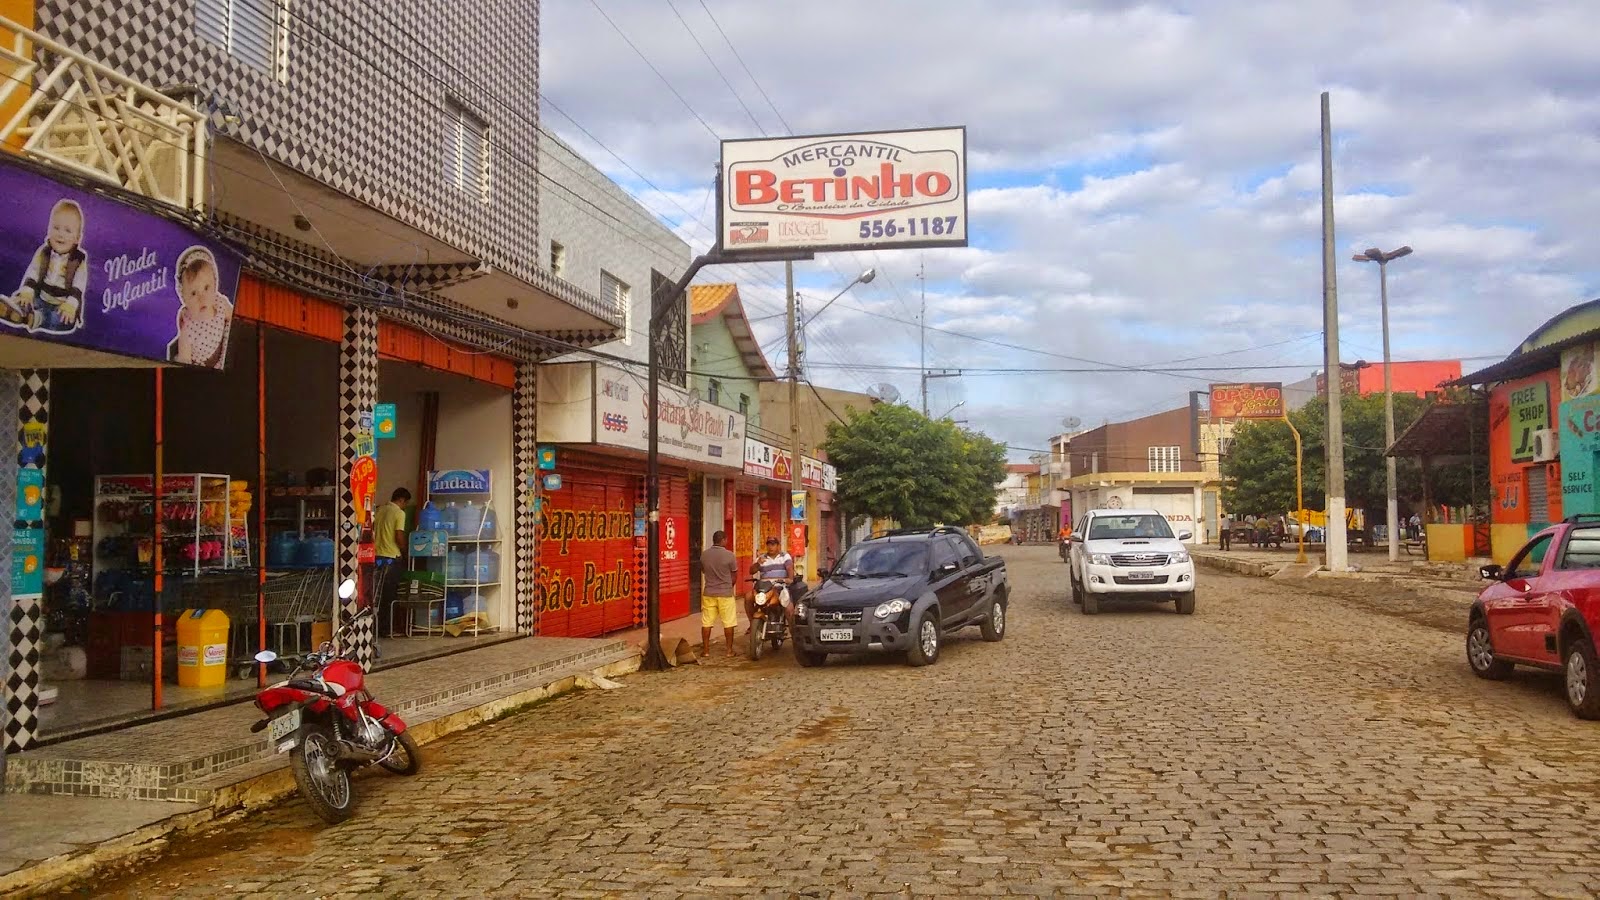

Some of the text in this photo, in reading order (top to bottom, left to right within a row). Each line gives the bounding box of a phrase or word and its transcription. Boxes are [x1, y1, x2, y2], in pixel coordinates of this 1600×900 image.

[782, 144, 903, 169] MERCANTIL
[828, 157, 855, 168] DO
[791, 203, 847, 211] Barateiro
[867, 199, 910, 207] Cidade
[859, 216, 958, 239] 556-1187
[104, 247, 157, 283] Moda
[101, 267, 168, 314] Infantil
[1512, 387, 1536, 407] FREE
[704, 411, 724, 437] Paulo
[1519, 404, 1544, 423] SHOP
[1568, 471, 1586, 482] SELF
[1563, 483, 1593, 494] SERVICE
[541, 494, 632, 555] Sapataria
[540, 560, 632, 613] São Paulo
[836, 632, 851, 640] 7359
